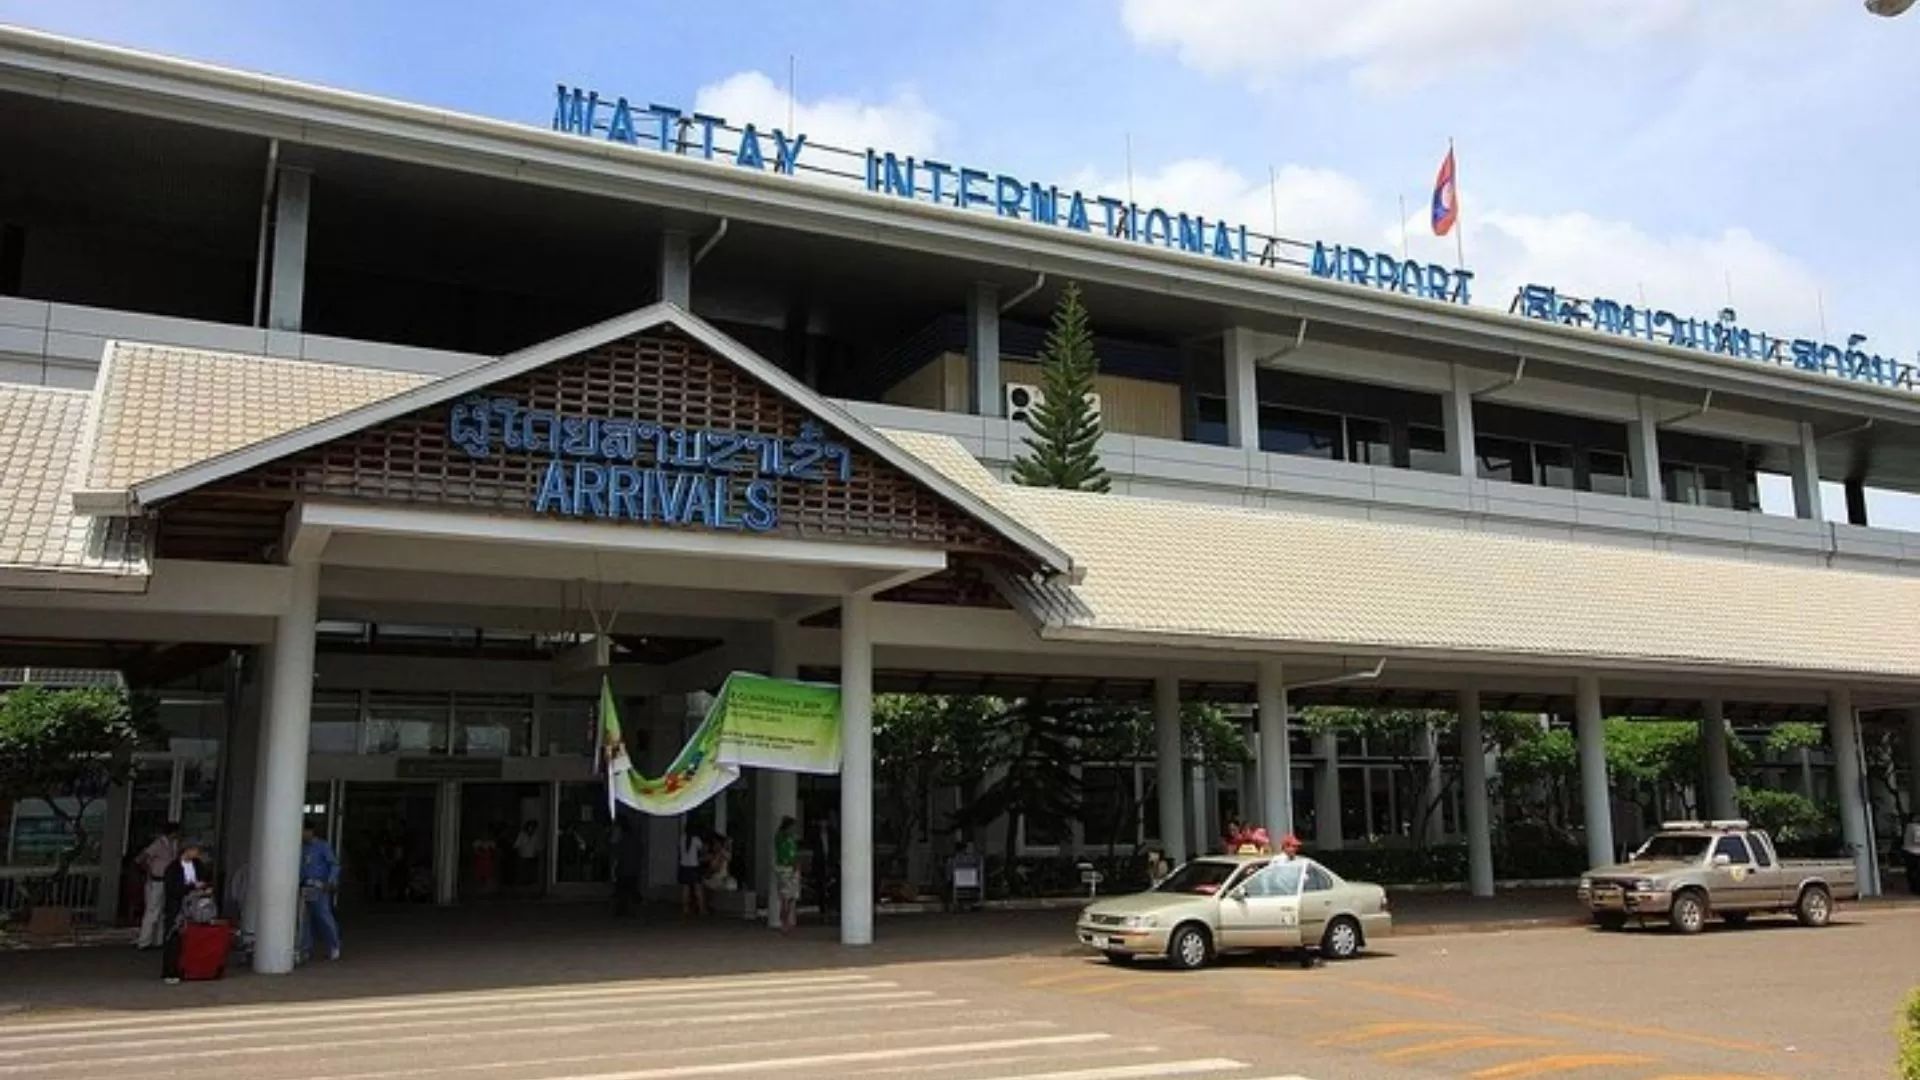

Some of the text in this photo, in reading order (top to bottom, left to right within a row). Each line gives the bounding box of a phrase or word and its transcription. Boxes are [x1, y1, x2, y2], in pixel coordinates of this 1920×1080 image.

[553, 84, 1474, 305] WATTAY INTERNATIONAL AIRPORT
[534, 457, 779, 531] ARRIVALS
